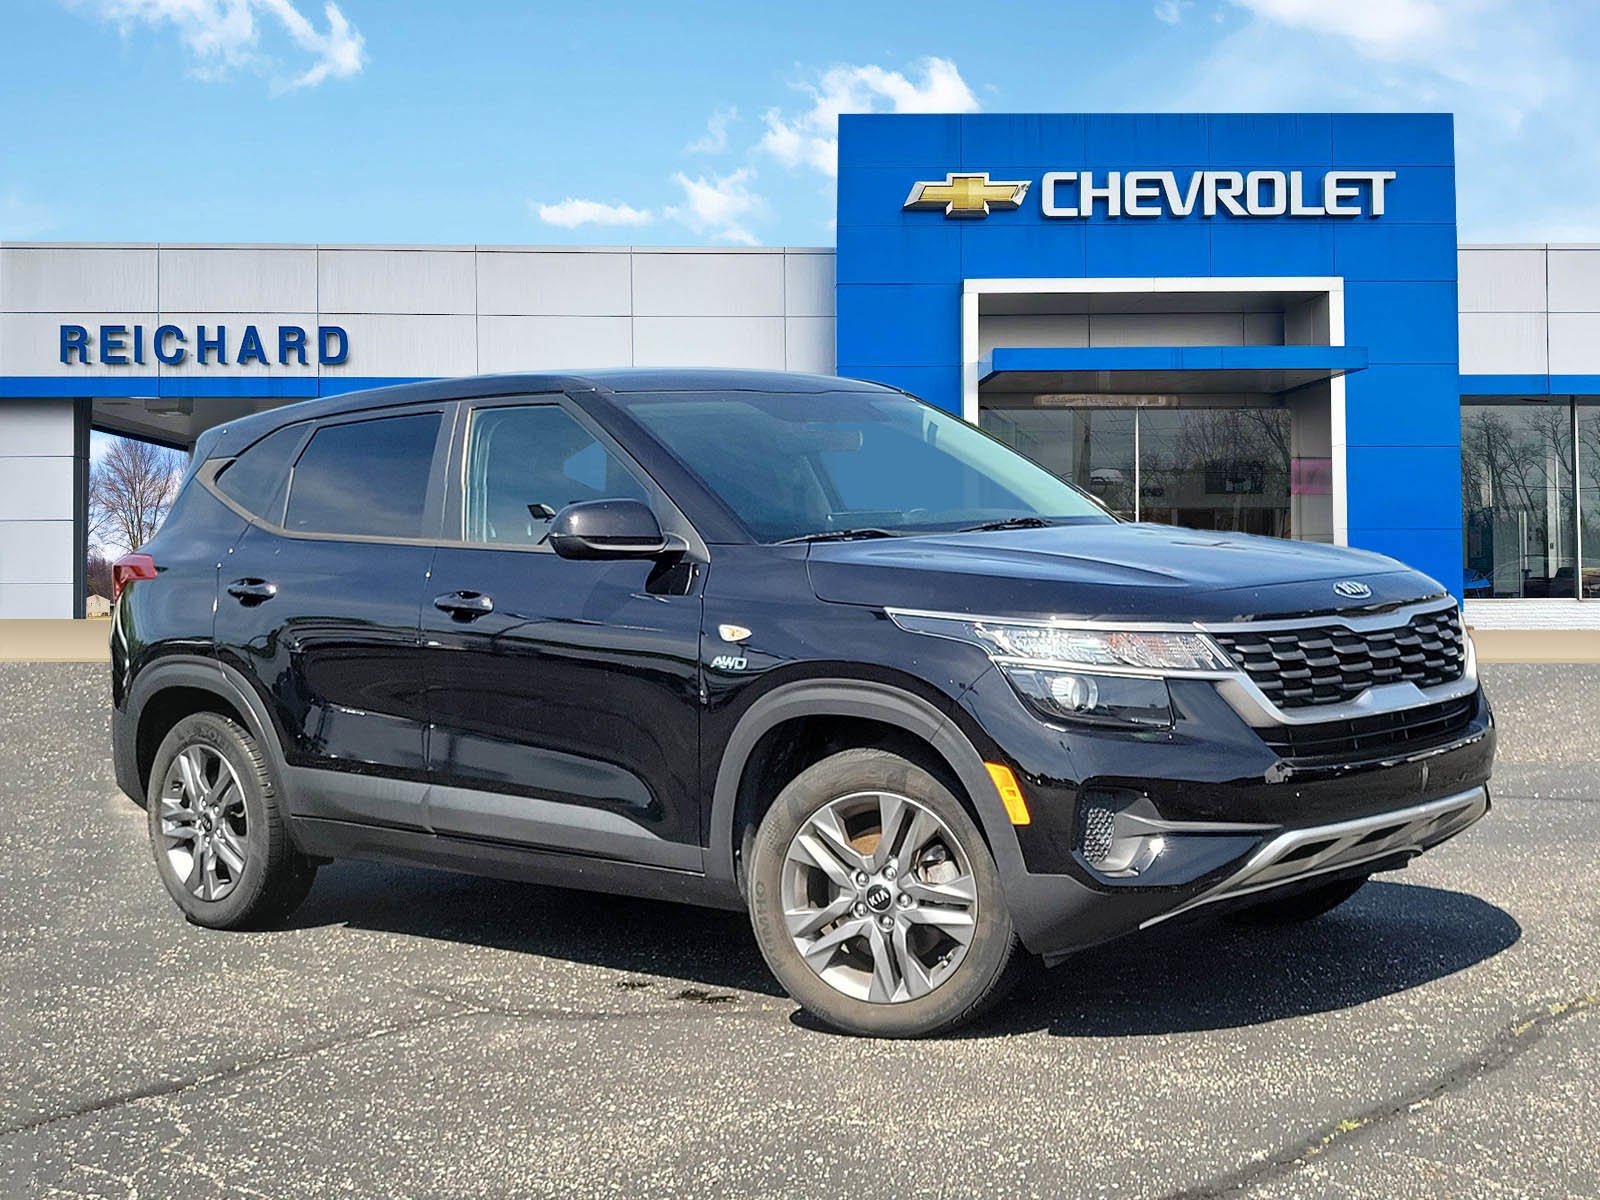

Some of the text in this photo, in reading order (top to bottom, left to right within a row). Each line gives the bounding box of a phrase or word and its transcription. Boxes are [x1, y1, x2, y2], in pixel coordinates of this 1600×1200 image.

[1042, 171, 1397, 217] CHEVROLET
[59, 325, 349, 366] REICHARD
[710, 656, 748, 670] AWD
[869, 889, 890, 906] KIA
